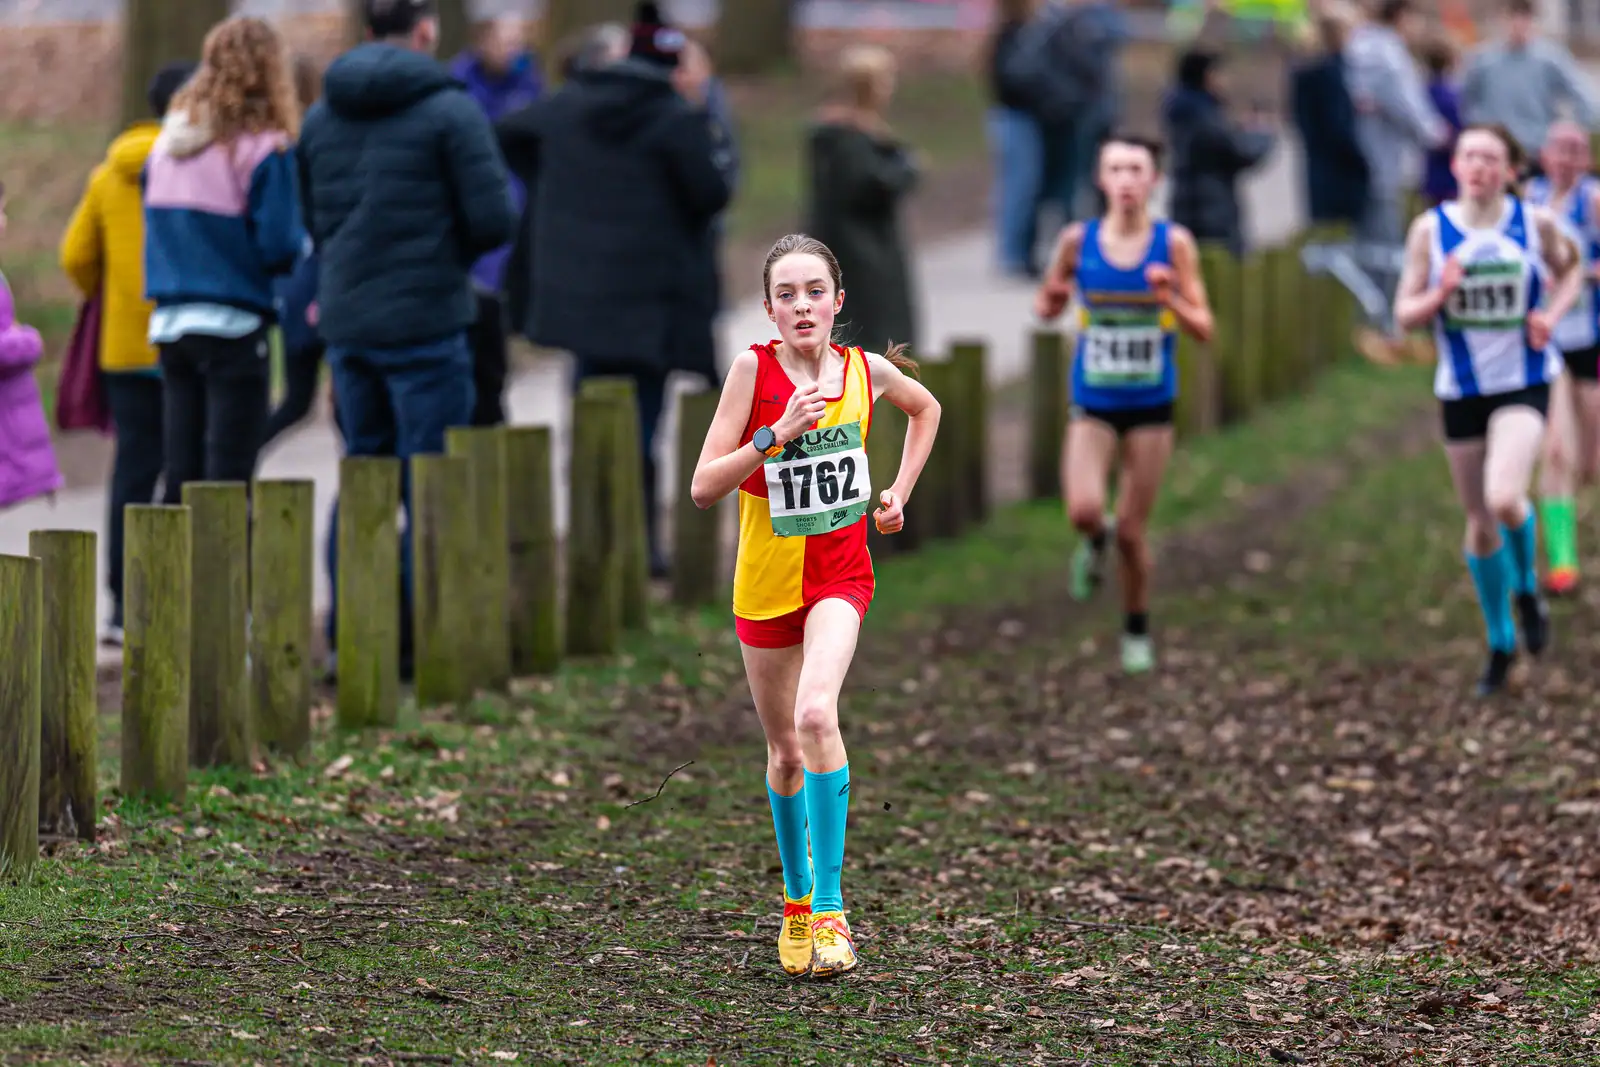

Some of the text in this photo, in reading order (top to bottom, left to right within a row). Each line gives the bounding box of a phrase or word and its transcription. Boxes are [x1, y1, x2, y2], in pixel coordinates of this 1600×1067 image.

[807, 440, 849, 452] CROSS CHALLENGE
[778, 457, 859, 510] 1762
